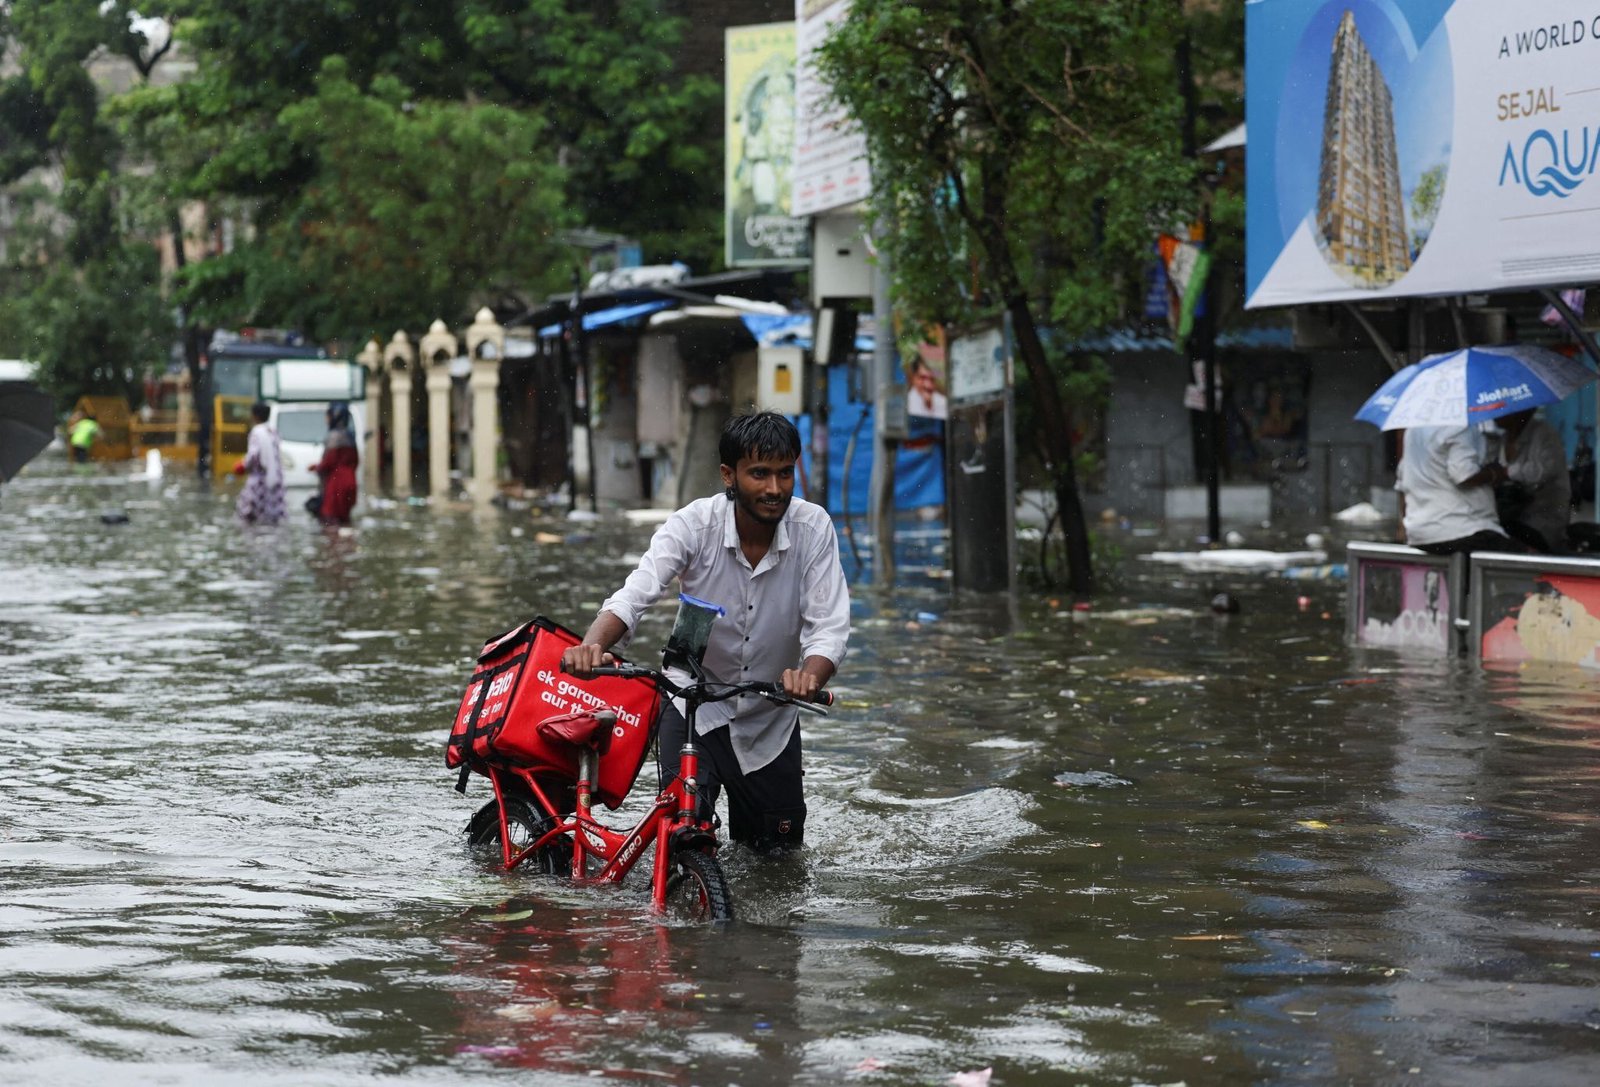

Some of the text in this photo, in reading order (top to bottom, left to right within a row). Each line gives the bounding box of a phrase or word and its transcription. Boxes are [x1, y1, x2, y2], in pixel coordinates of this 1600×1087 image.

[1498, 36, 1510, 59] A
[1516, 20, 1585, 55] WORLD
[1497, 86, 1561, 121] SEJAL
[1476, 383, 1530, 404] JioMart
[467, 672, 513, 706] zato
[537, 670, 556, 686] ek
[557, 681, 607, 710] garam
[541, 691, 568, 709] aur
[618, 835, 643, 866] HERO
